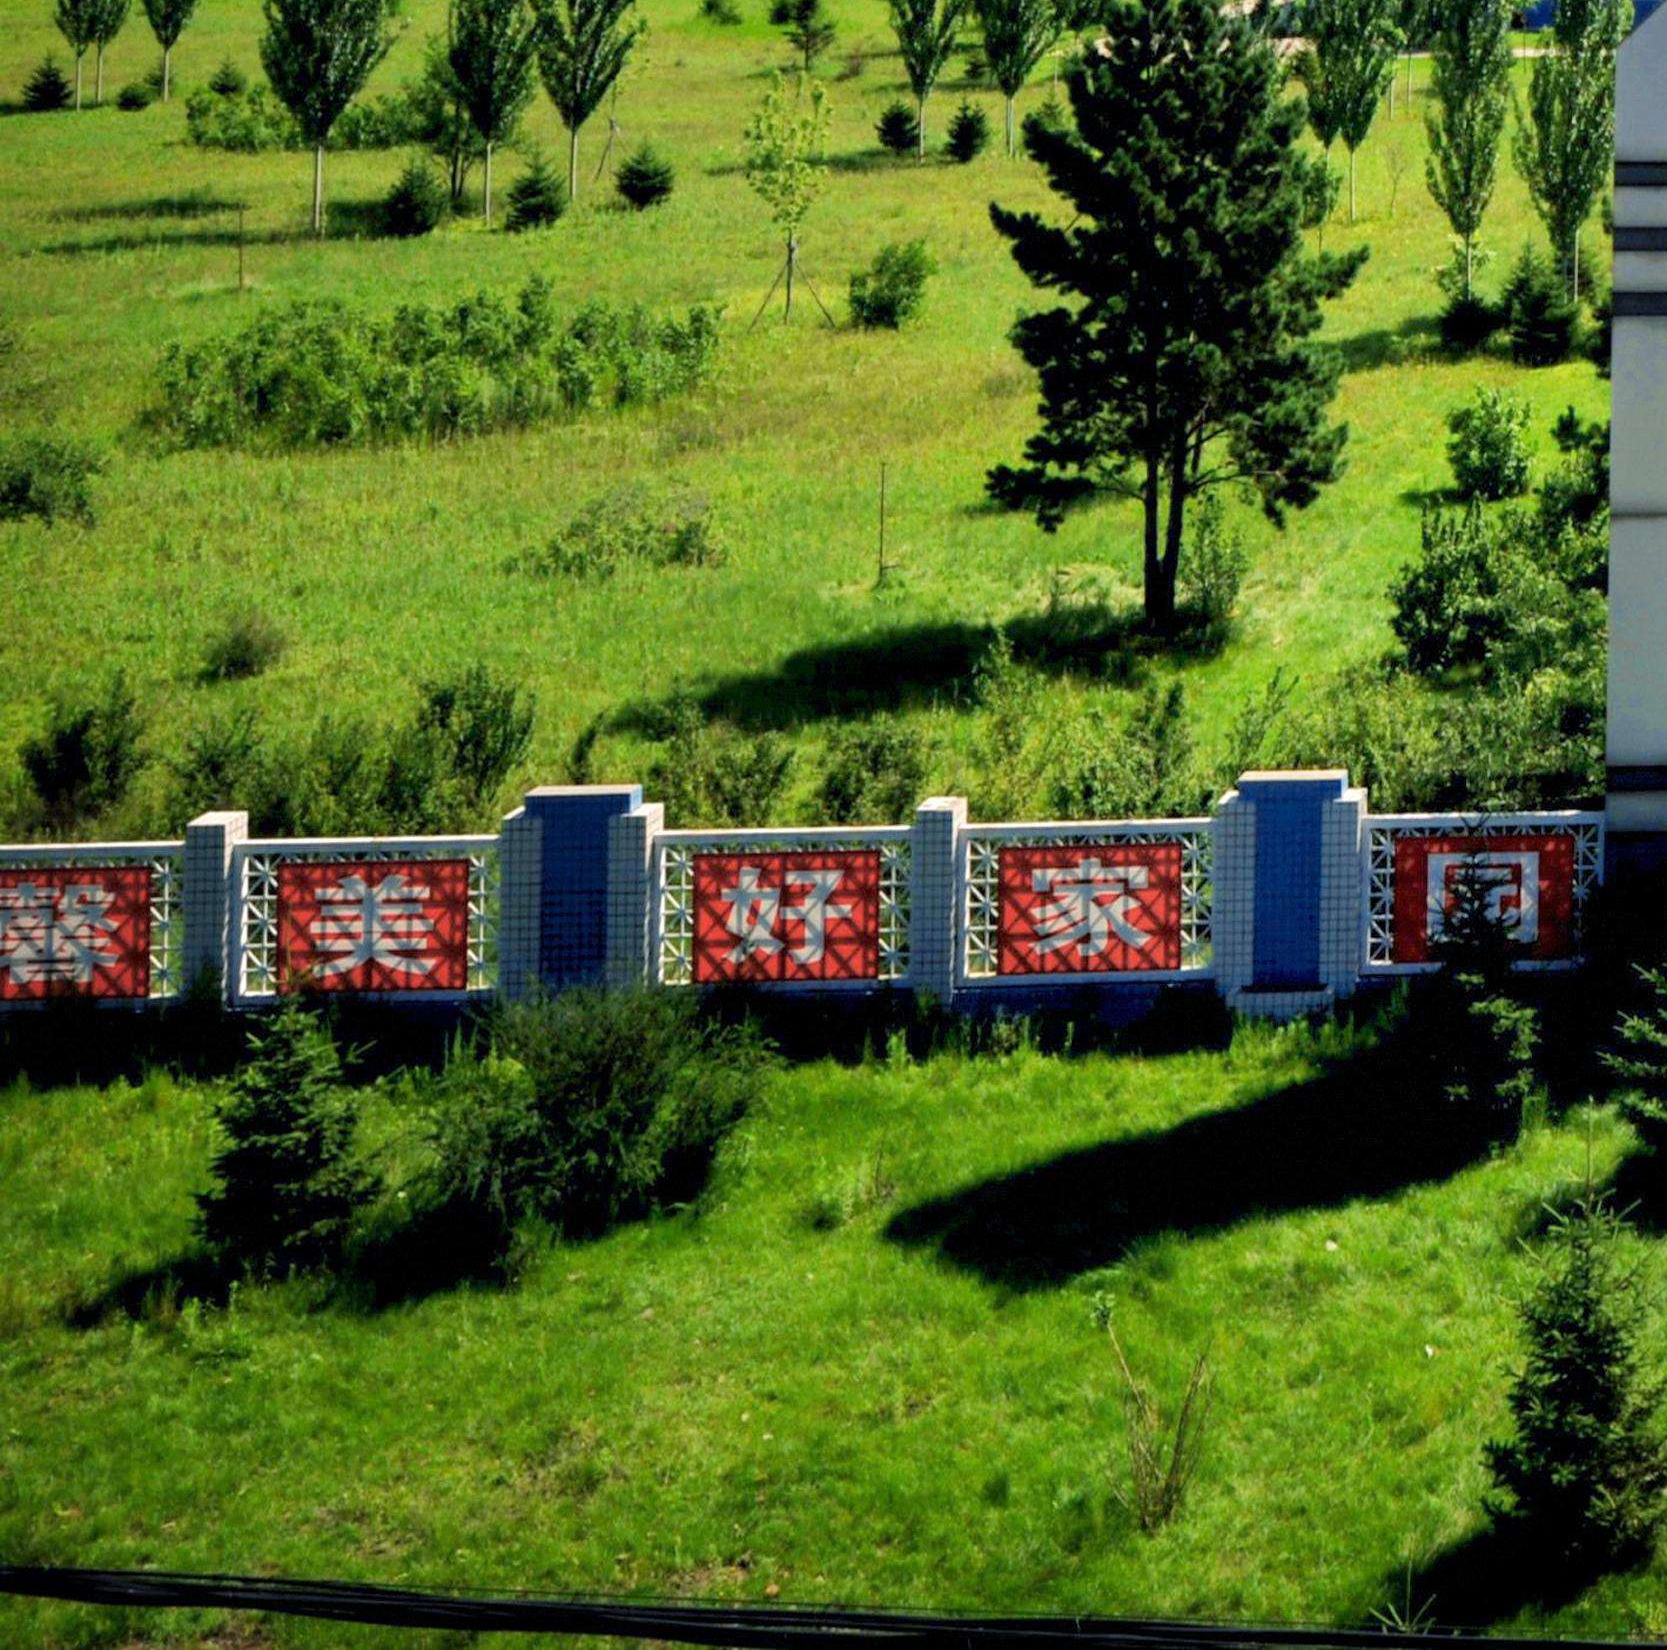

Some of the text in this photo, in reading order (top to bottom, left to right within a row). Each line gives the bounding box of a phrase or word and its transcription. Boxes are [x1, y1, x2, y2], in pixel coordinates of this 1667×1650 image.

[310, 873, 435, 979] 美
[721, 866, 853, 964] 好
[1031, 859, 1151, 956] 家
